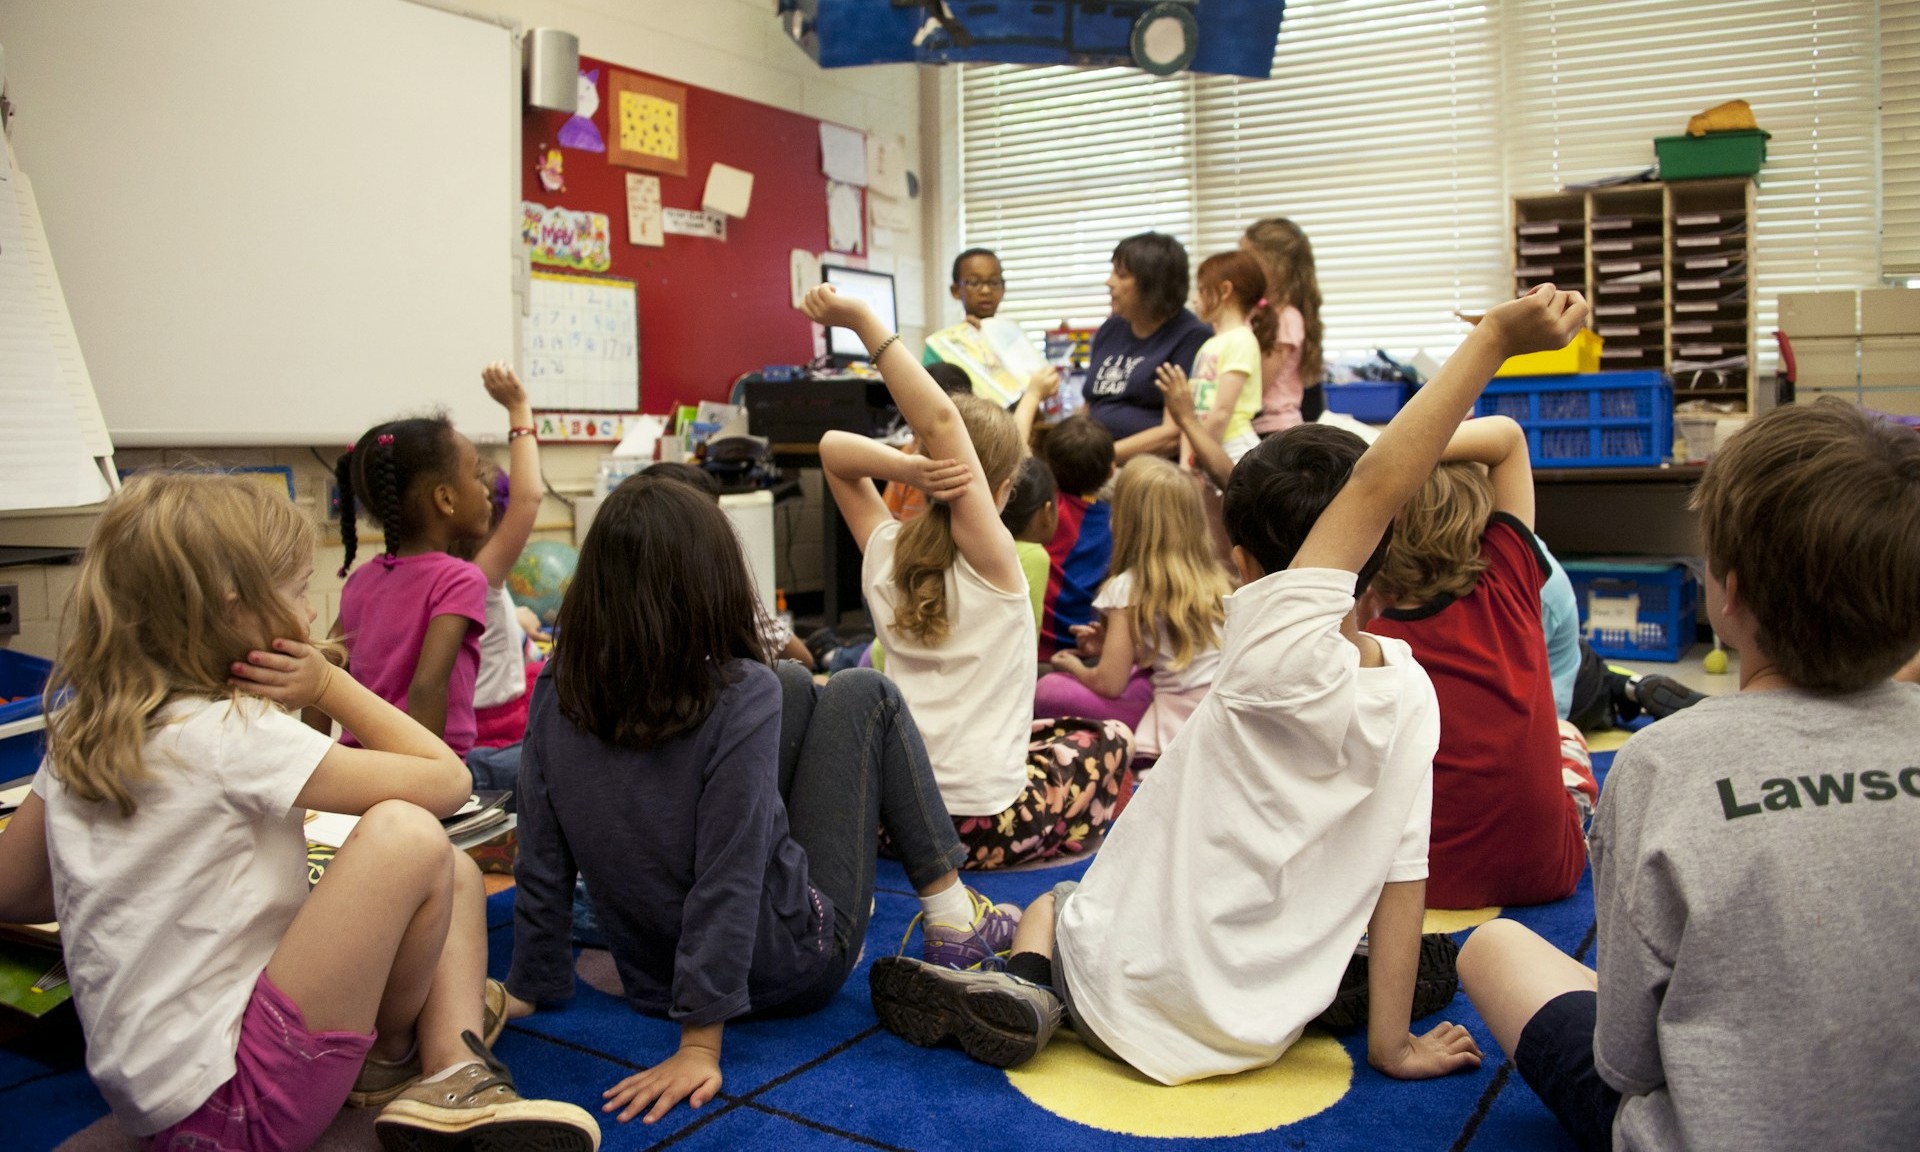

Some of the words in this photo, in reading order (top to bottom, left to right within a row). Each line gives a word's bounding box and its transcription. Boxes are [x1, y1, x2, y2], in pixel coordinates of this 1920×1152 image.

[541, 420, 553, 435] A
[571, 421, 581, 435] B
[600, 420, 611, 435] C
